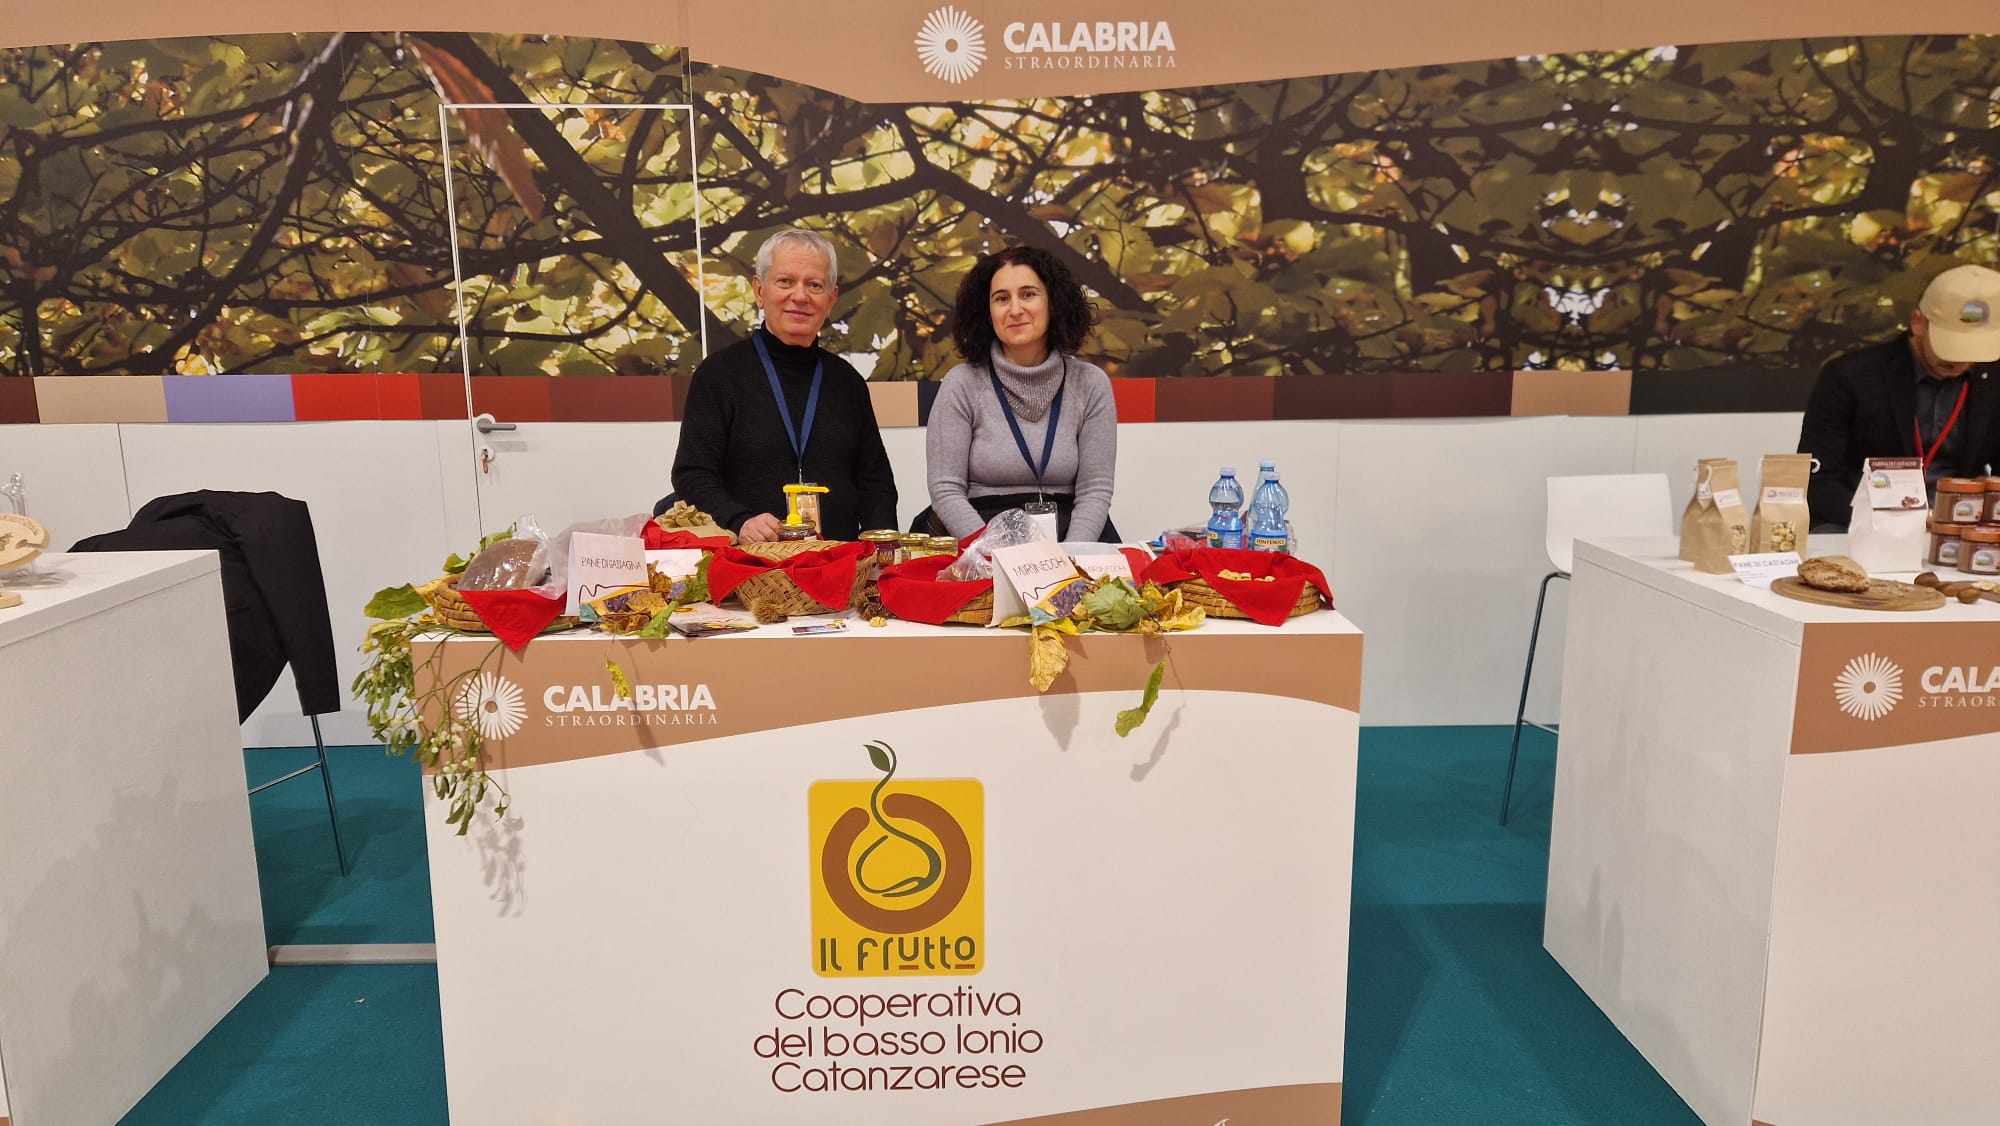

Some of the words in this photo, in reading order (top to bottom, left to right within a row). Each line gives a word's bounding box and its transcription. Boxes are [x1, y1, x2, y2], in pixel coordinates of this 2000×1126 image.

[1003, 21, 1176, 53] CALABRIA
[1004, 55, 1177, 69] STRAORDINARIA
[581, 557, 601, 568] PANE
[543, 684, 717, 713] CALABRIA
[545, 713, 718, 727] STRAORDINARIA
[820, 938, 842, 972] Il
[857, 935, 976, 971] Frutto
[775, 985, 1021, 1027] Cooperativa
[753, 1027, 813, 1058] del
[823, 1026, 946, 1057] basso
[957, 1022, 1043, 1054] Ionio
[771, 1061, 1026, 1092] Catanzarese
